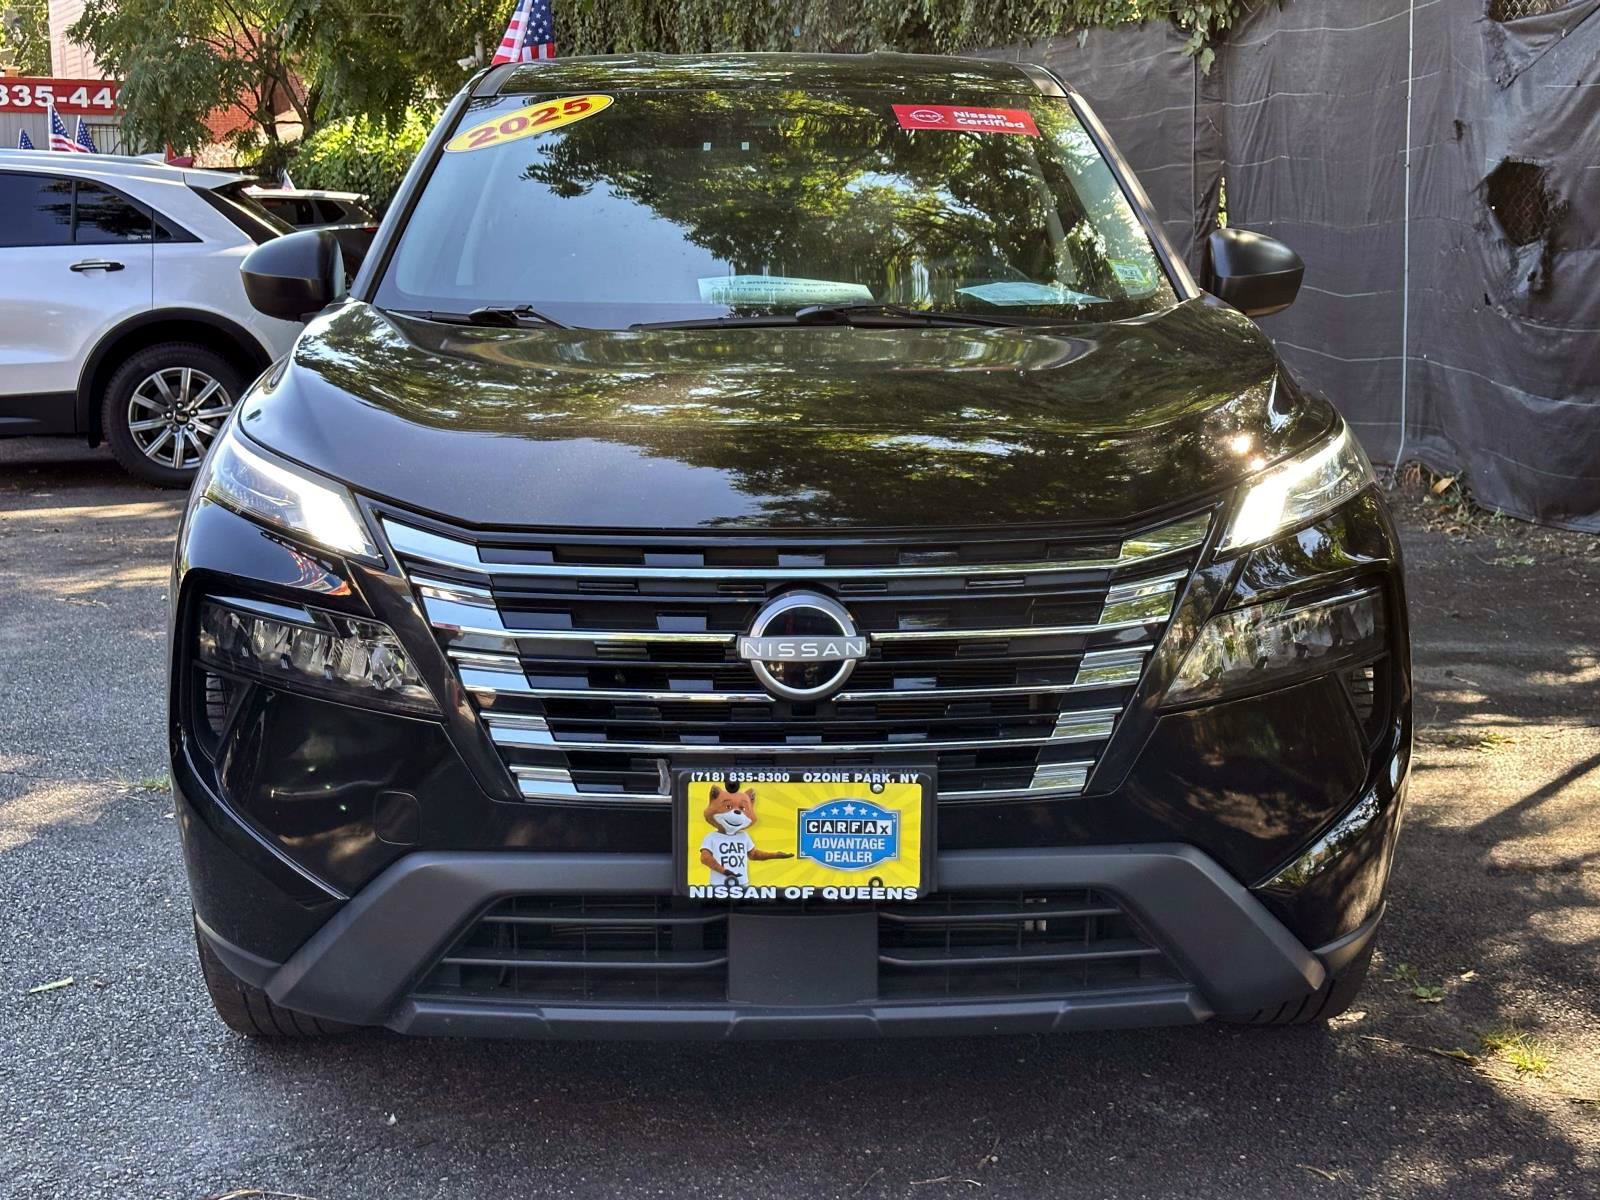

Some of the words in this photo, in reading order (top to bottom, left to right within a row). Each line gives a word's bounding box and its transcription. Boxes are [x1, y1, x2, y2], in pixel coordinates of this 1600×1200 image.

[953, 111, 1007, 120] Nissan
[468, 97, 592, 148] 2025
[956, 118, 1025, 129] Certified
[744, 641, 863, 657] NISSAN
[691, 772, 725, 782] (718)
[729, 772, 790, 782] 835-8300
[803, 772, 850, 783] OZONE
[854, 773, 895, 783] PARK,
[900, 773, 919, 783] NY
[808, 820, 889, 834] CARFAX
[719, 842, 745, 854] CAR
[813, 837, 885, 850] ADVANTAGE
[721, 855, 745, 868] FOX
[825, 850, 872, 863] DEALER
[689, 886, 777, 899] NISSAN
[784, 886, 815, 899] OF
[822, 887, 918, 900] QUEENS
